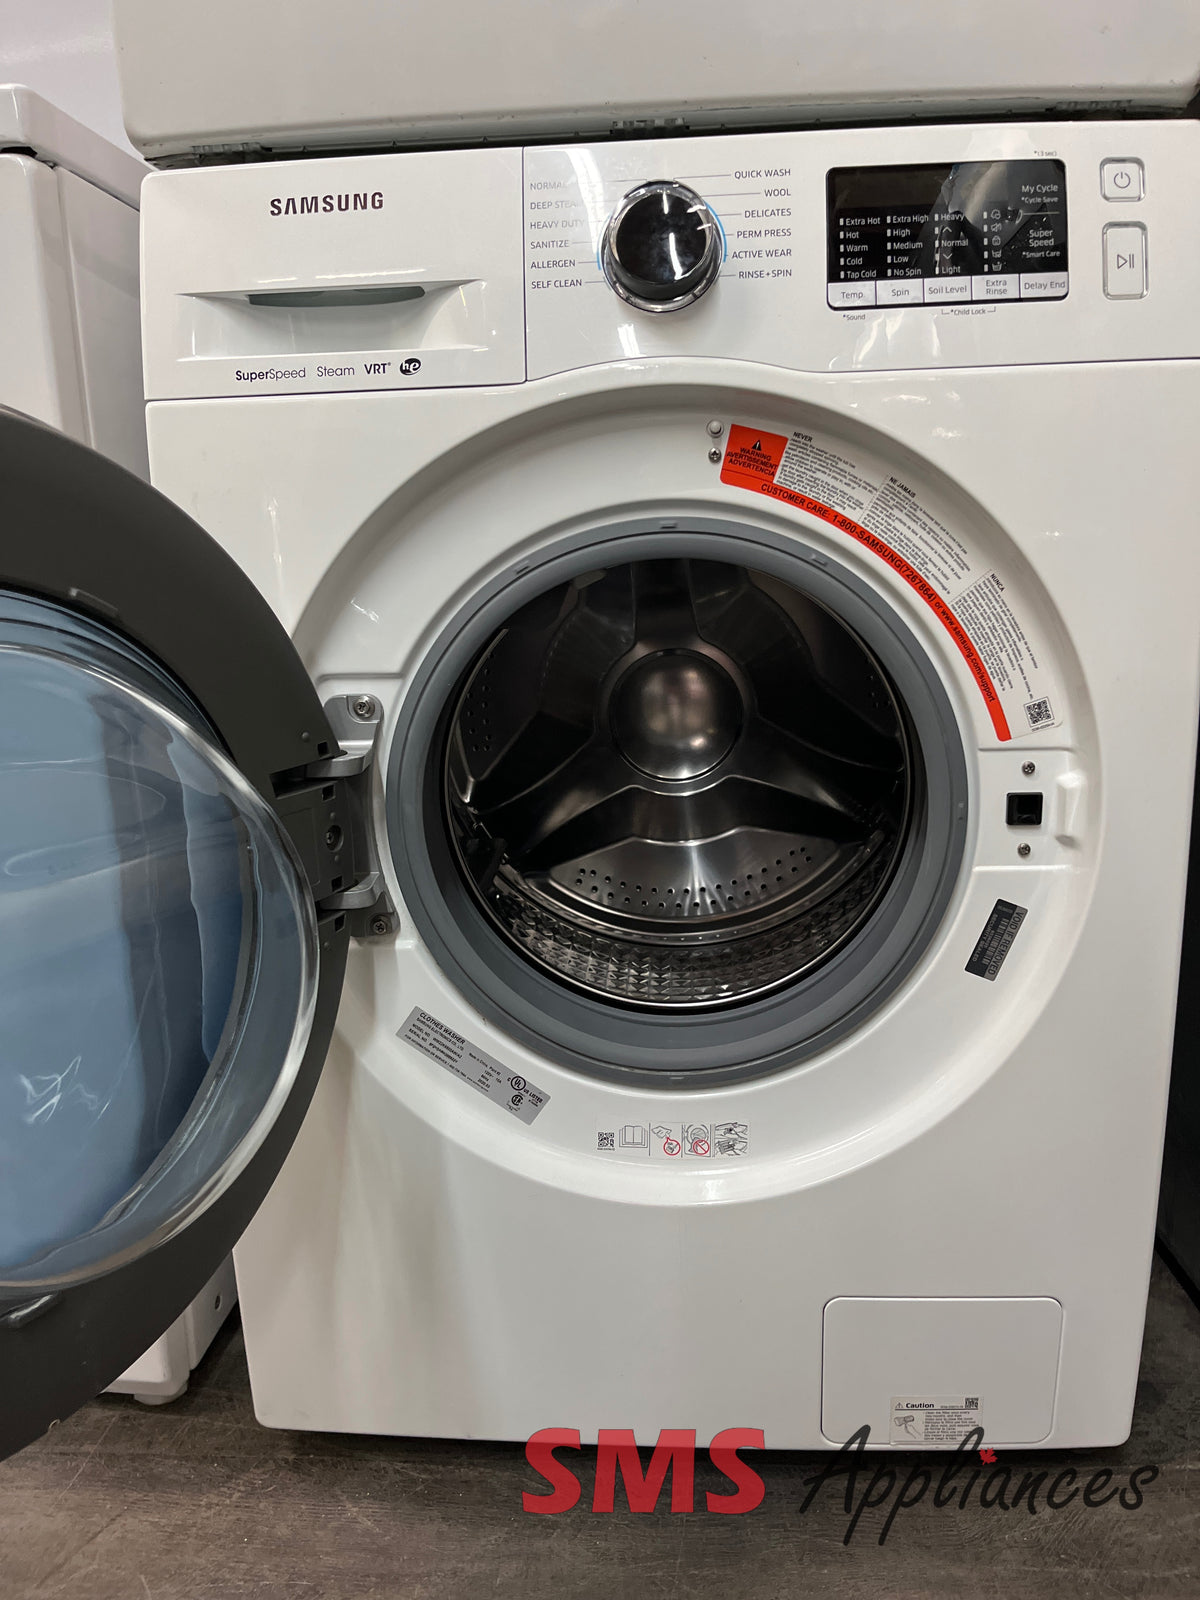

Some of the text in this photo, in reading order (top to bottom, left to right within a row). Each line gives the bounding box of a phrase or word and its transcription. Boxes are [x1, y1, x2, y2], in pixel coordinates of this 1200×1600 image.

[734, 168, 791, 180] QUICK WASH
[764, 188, 791, 197] WOOL
[1022, 184, 1058, 194] My Cycle
[270, 192, 384, 216] SAMSUNG
[530, 201, 552, 210] DEEP
[744, 208, 792, 218] DELICATES
[941, 213, 964, 221] Heavy
[846, 217, 880, 226] Extra Hot
[892, 214, 929, 223] Extra High
[530, 219, 584, 230] HEAVY DUTY
[736, 228, 792, 239] PERM PRESS
[846, 231, 859, 239] Hot
[892, 229, 910, 237] High
[1029, 229, 1053, 238] Super
[530, 240, 569, 249] SANITIZE
[893, 242, 923, 250] Medium
[941, 239, 969, 247] Normal
[1029, 239, 1054, 247] Speed
[846, 244, 868, 252] Warm
[732, 249, 792, 259] ACTIVE WEAR
[530, 260, 576, 269] ALLERGEN
[846, 258, 863, 266] Cold
[739, 269, 792, 279] RINSE+SPIN
[905, 268, 921, 277] Spin
[942, 265, 961, 274] Light
[847, 270, 876, 279] Tap Cold
[531, 279, 582, 289] SELF CLEAN
[986, 279, 1007, 287] Extra
[1024, 281, 1066, 290] Delay End
[891, 288, 910, 297] Spin
[928, 285, 967, 294] Soil Level
[841, 291, 863, 300] Temp
[235, 367, 306, 382] SuperSpeed
[317, 366, 355, 378] Steam
[793, 432, 813, 442] NEVER
[740, 447, 772, 461] WARNING
[726, 451, 778, 470] AVERTISSEMENT
[728, 458, 775, 477] ADVERTENCIA
[761, 484, 804, 506] CUSTOMER
[806, 502, 829, 518] CARE:
[934, 602, 943, 611] or
[990, 574, 1006, 592] NUNCA
[1010, 912, 1024, 930] VOID
[1006, 930, 1014, 939] IF
[988, 938, 1010, 975] REMOVED
[420, 1012, 466, 1045] CLOTHES WASHER
